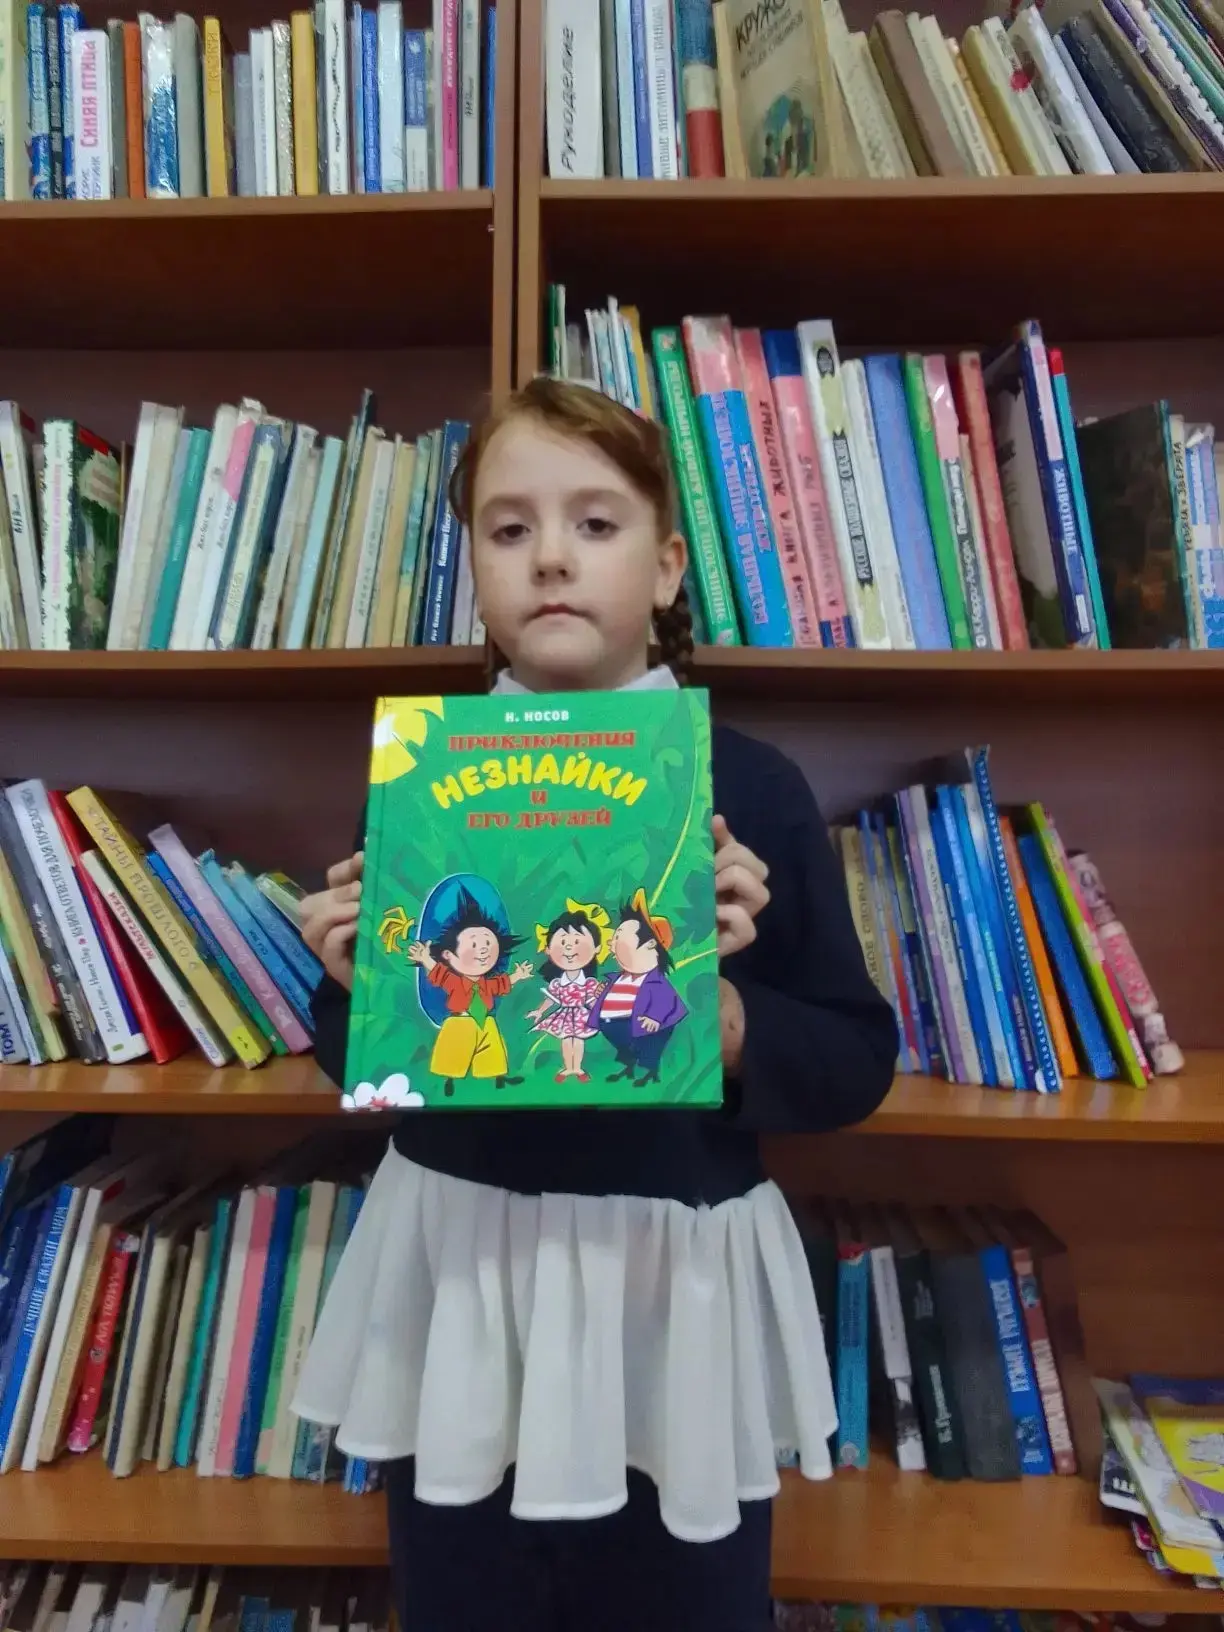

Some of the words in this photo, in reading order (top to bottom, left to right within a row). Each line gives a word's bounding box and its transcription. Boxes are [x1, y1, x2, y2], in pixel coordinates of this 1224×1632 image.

[1052, 467, 1078, 555] ЖИВОТНЫЕ
[505, 711, 520, 723] Н.
[524, 710, 569, 722] НОСОВ
[449, 731, 636, 751] ПРИКЛЮЧЕНИЯ
[431, 752, 647, 809] НЕЗНАЙКИ
[531, 790, 548, 805] И
[468, 812, 510, 829] ЕГО
[515, 806, 612, 829] ДРУЗЕЙ
[93, 815, 131, 871] ТАЙНЫ
[129, 871, 191, 958] ПРОШЛОГО
[63, 906, 84, 938] КНИГА
